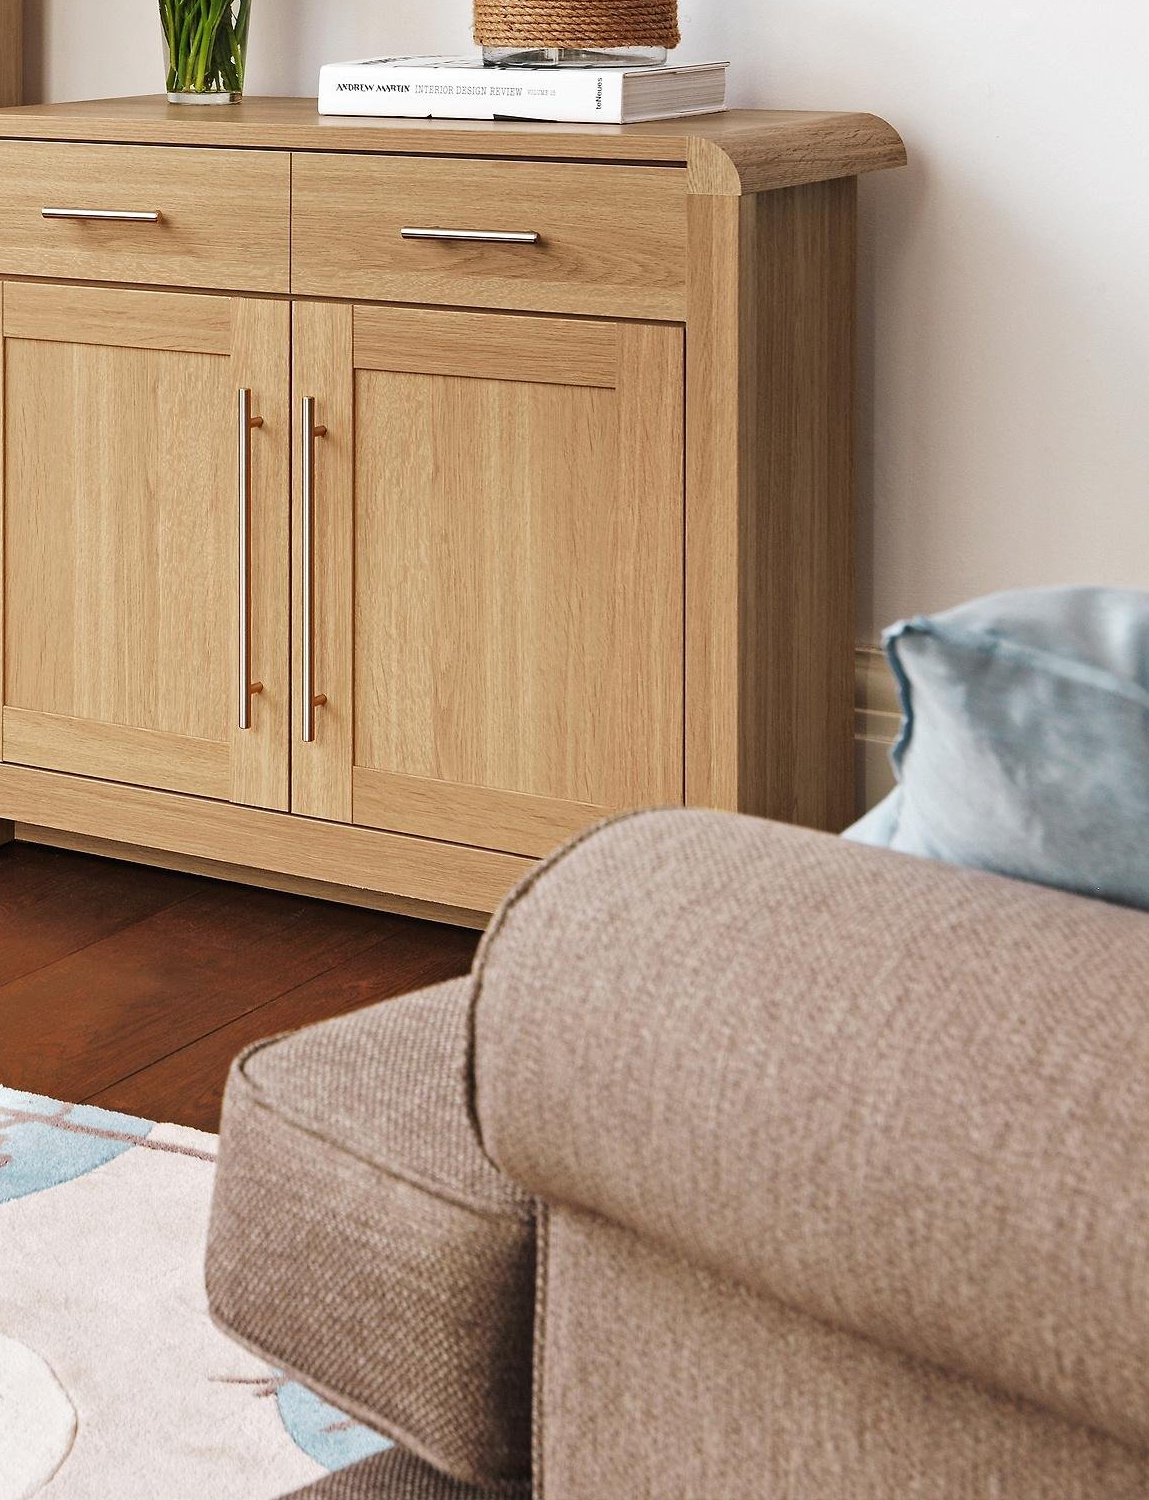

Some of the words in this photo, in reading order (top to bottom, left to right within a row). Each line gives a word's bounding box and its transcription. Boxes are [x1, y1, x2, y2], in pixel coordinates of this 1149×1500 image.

[336, 83, 375, 92] ANDREW
[376, 84, 410, 93] MARTIN
[414, 84, 454, 95] INTERIOR
[456, 85, 487, 96] DESIGN
[490, 86, 523, 97] REVIEW
[595, 77, 603, 110] teNeues
